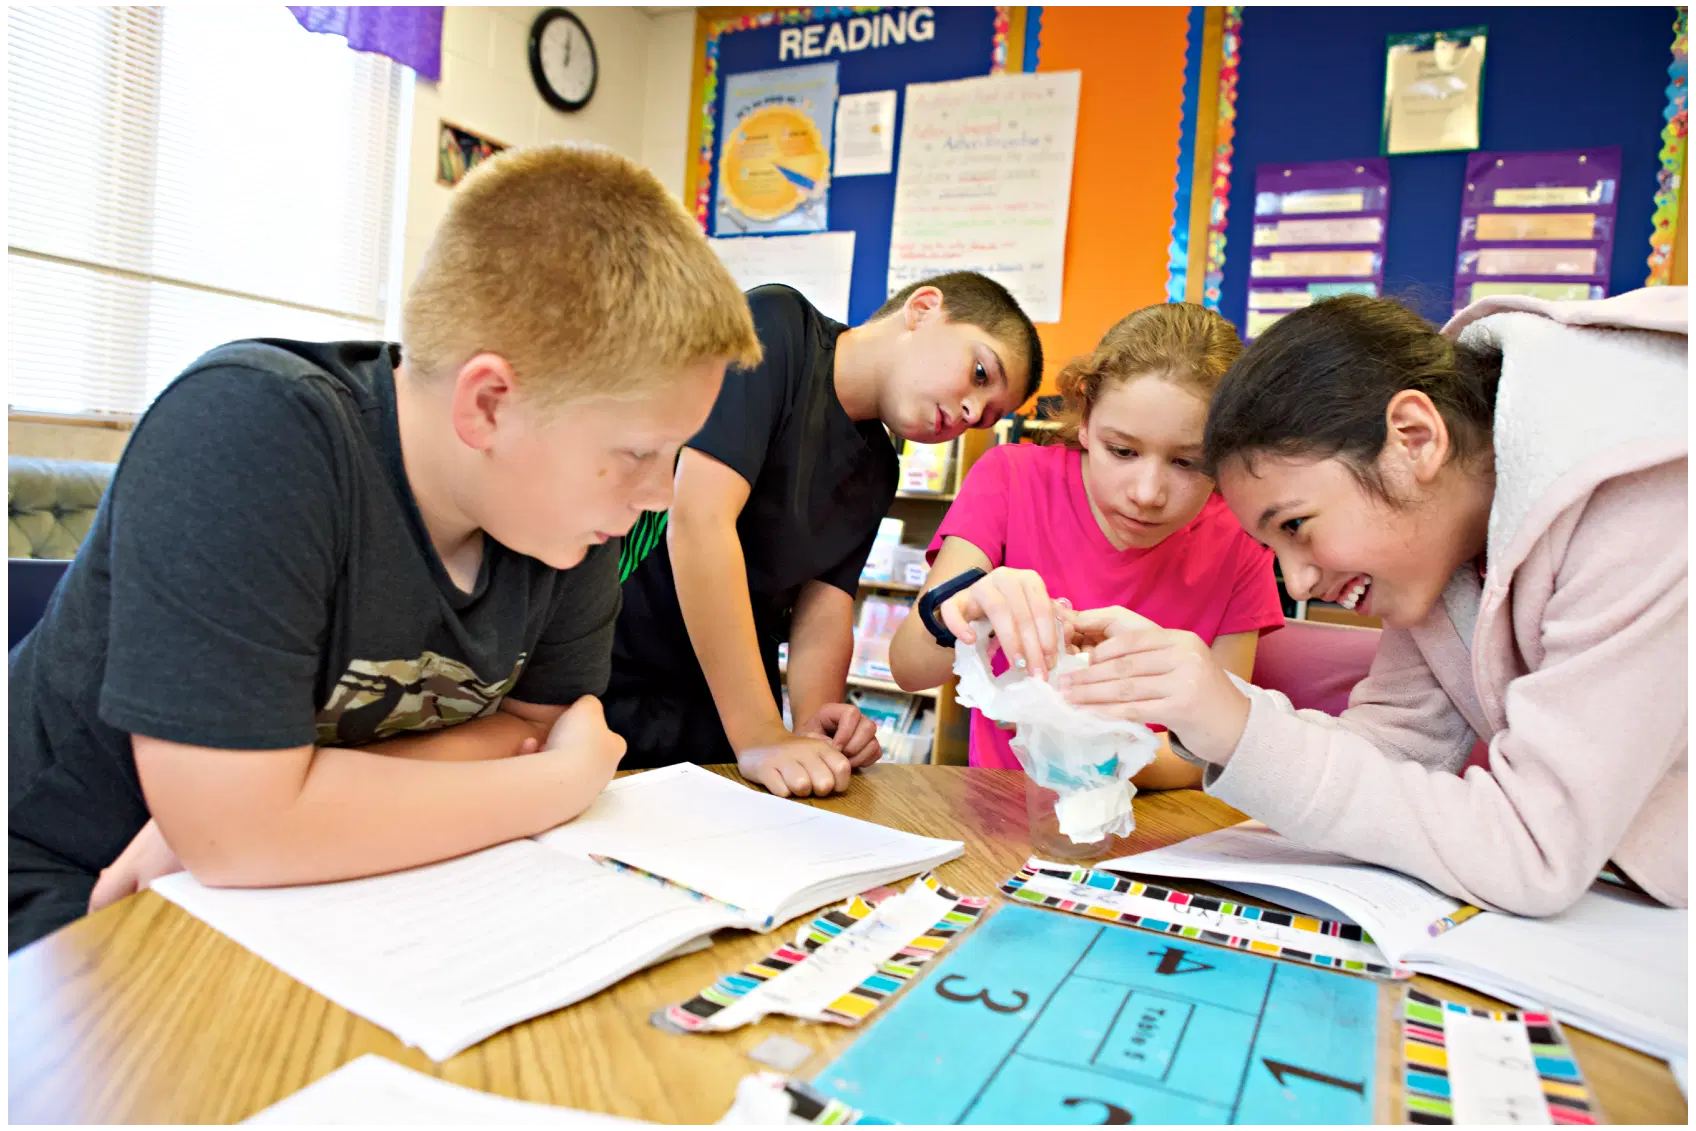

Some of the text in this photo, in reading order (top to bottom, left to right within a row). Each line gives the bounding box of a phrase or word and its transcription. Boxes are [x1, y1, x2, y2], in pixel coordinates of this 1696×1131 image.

[779, 7, 935, 61] READING
[1147, 945, 1216, 975] 4
[935, 974, 1029, 1013] 3
[1130, 1007, 1166, 1047] Table
[1261, 1057, 1365, 1103] 1
